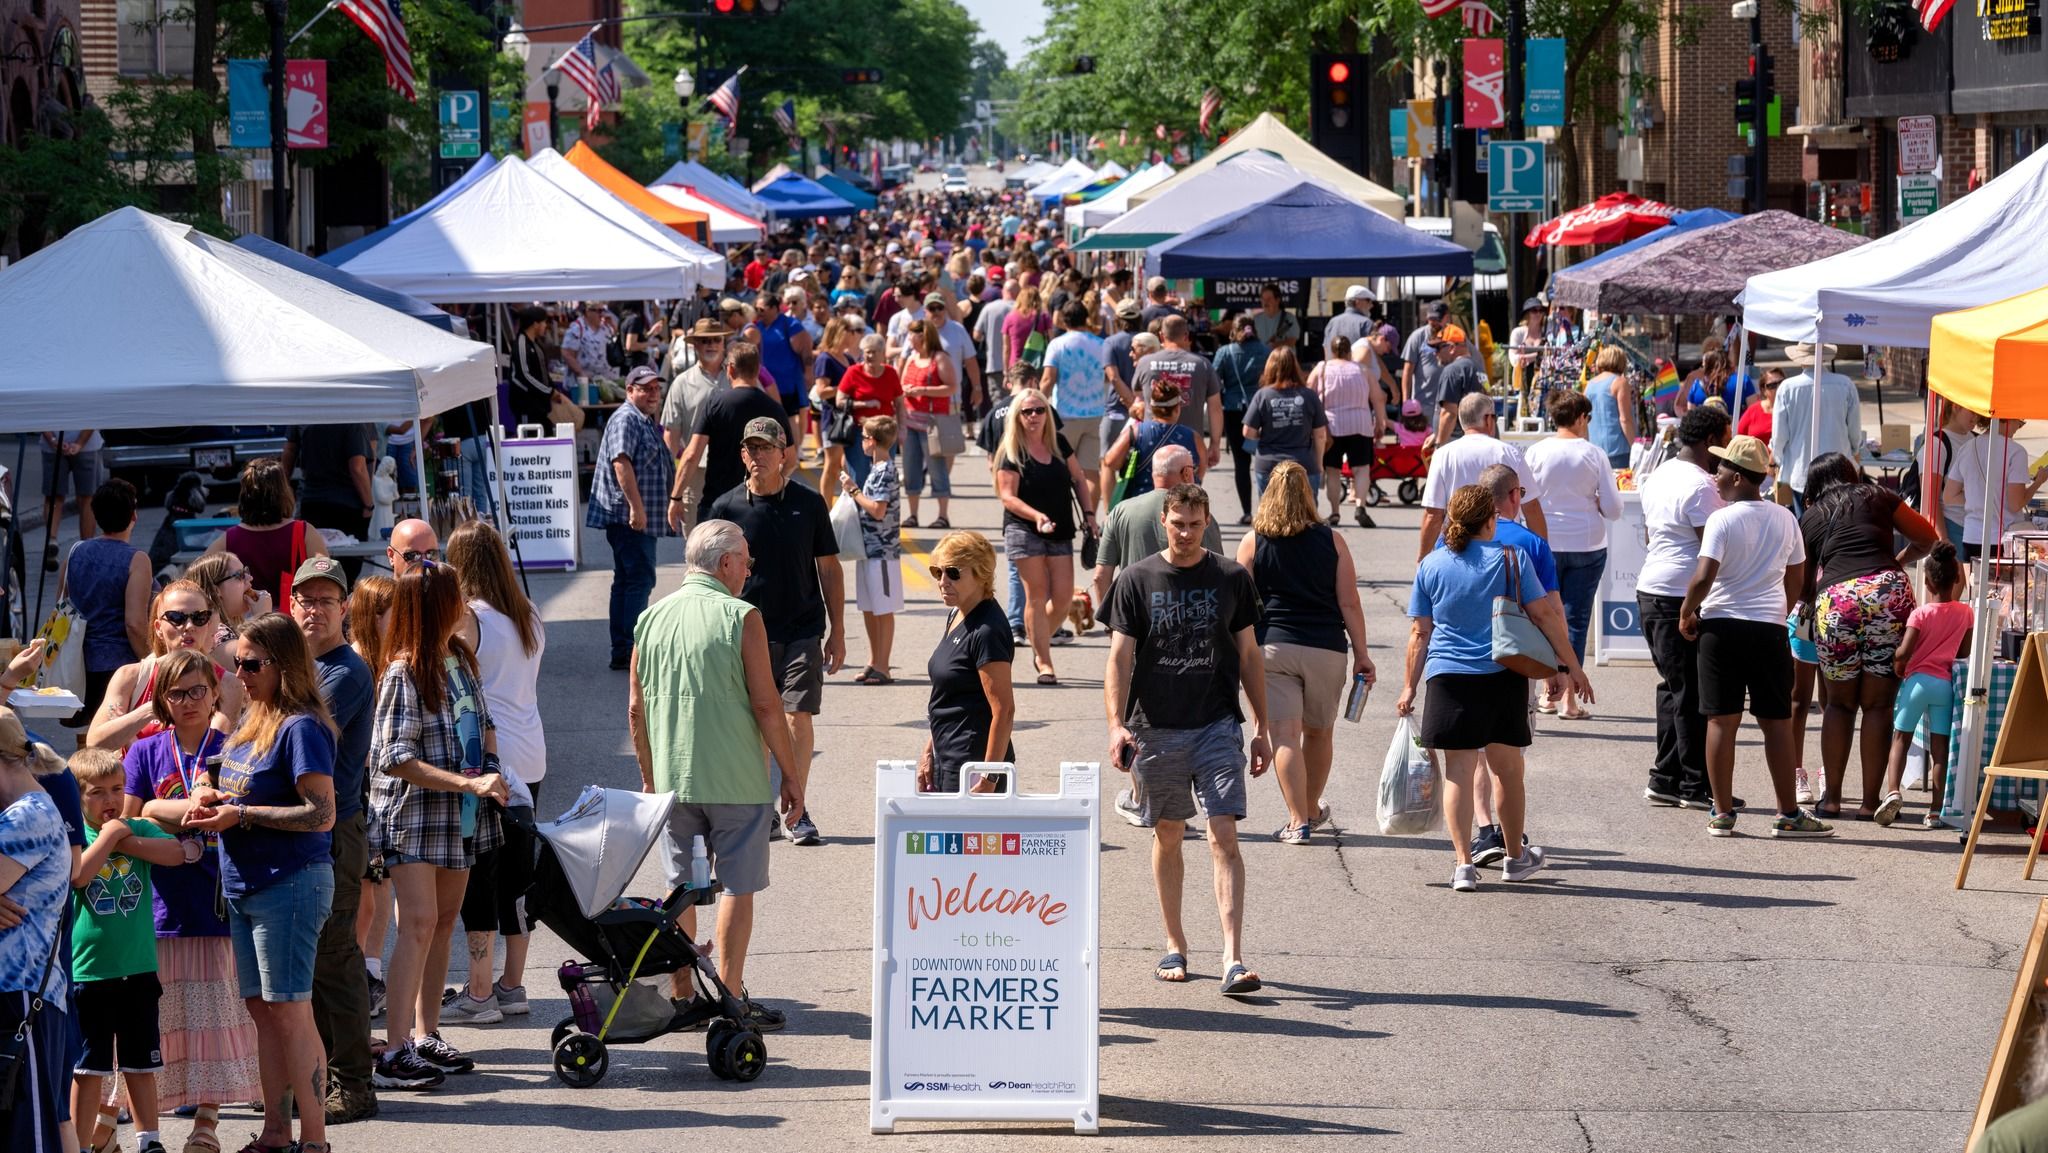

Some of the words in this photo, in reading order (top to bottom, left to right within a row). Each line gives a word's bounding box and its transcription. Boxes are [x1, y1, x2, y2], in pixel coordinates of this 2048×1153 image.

[449, 94, 473, 124] P
[1900, 119, 1910, 131] NO
[1498, 145, 1536, 194] P
[1903, 190, 1935, 198] Customer
[1907, 199, 1932, 208] Parking
[1912, 207, 1928, 215] Zone
[510, 455, 551, 467] Jewelry
[489, 471, 516, 482] Bby
[518, 472, 525, 480] &
[527, 469, 572, 481] Baptism
[511, 484, 553, 496] Crucifix
[494, 500, 543, 511] Cristian
[545, 499, 569, 510] Kids
[546, 528, 571, 540] Gifts
[1152, 589, 1218, 607] BLICK
[1158, 648, 1215, 675] everyone!
[1021, 839, 1066, 848] FARMERS
[1021, 847, 1066, 856] MARKET
[907, 872, 1068, 930] Welcome
[912, 957, 982, 971] DOWNTOWN
[986, 958, 1017, 971] FOND
[1020, 958, 1036, 971] DU
[1039, 958, 1060, 971] LAC
[912, 977, 1059, 1002] FARMERS
[911, 1005, 1059, 1030] MARKET
